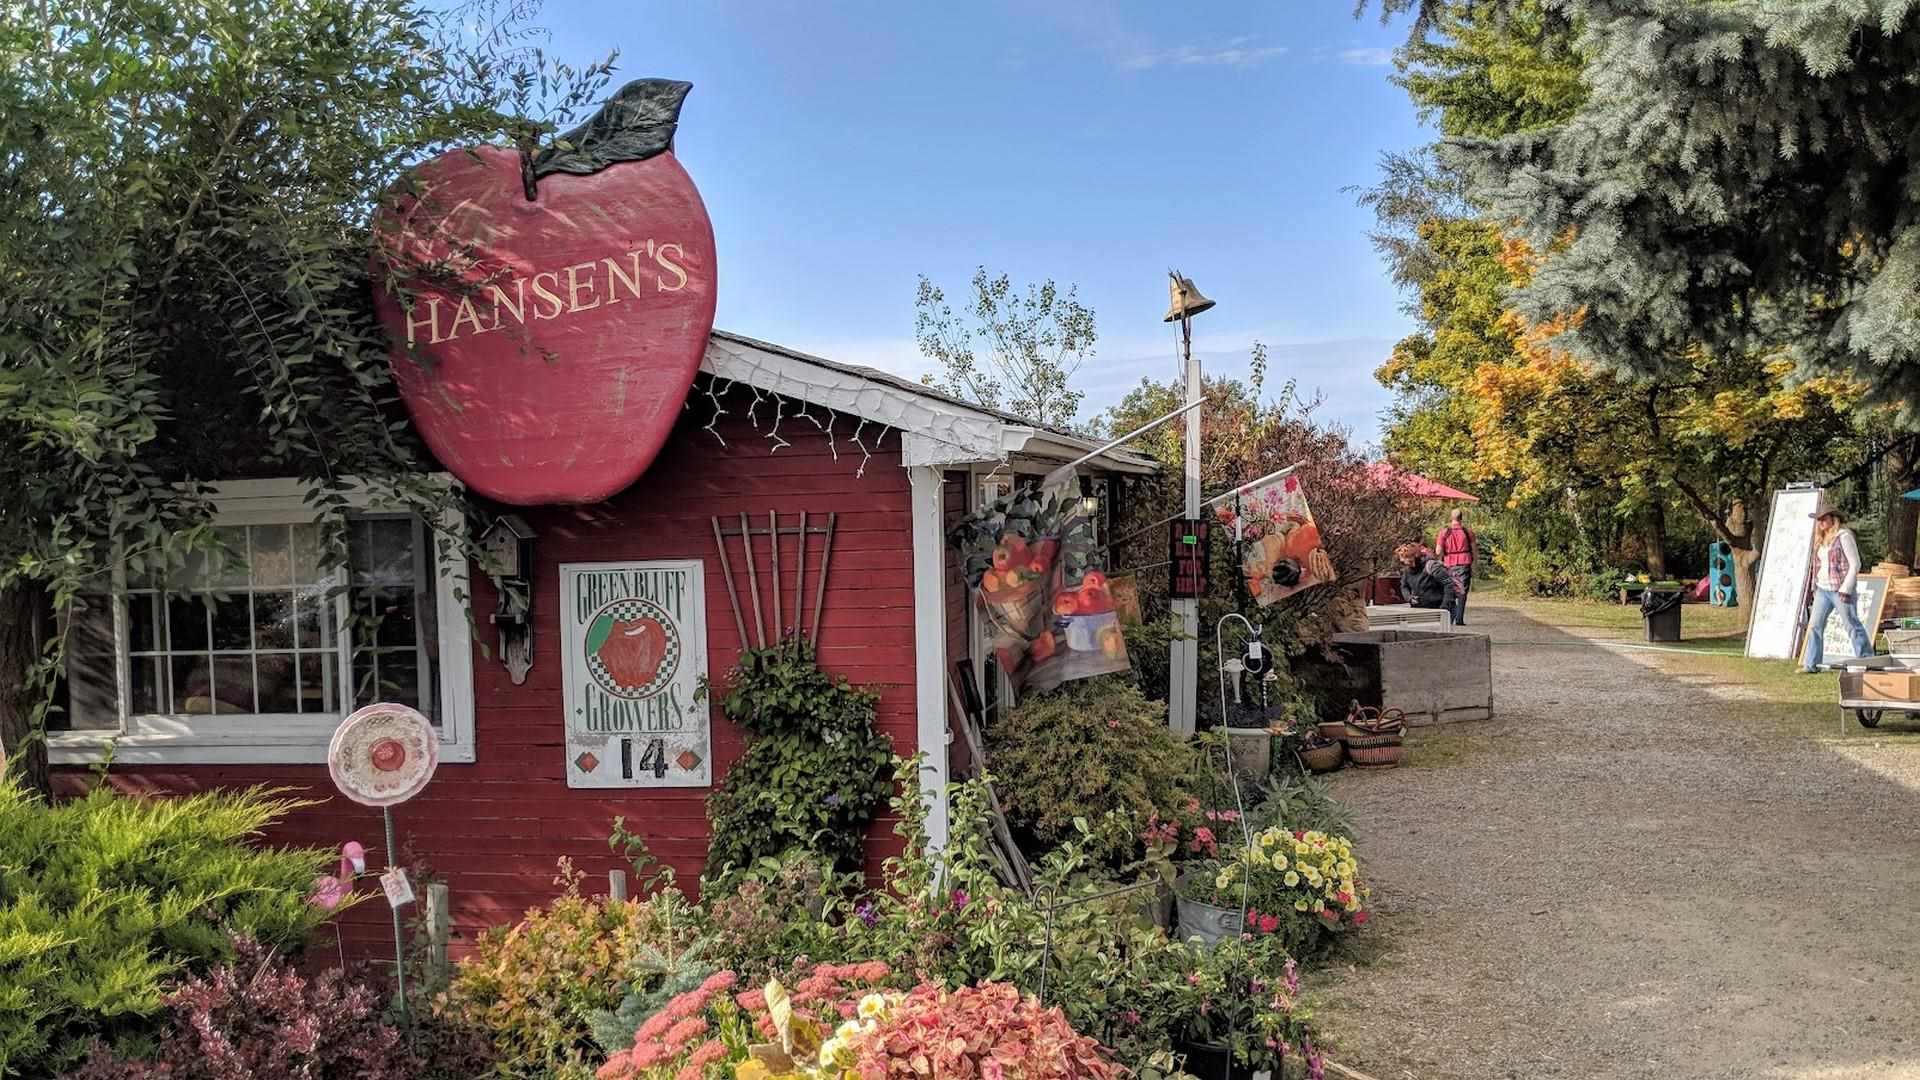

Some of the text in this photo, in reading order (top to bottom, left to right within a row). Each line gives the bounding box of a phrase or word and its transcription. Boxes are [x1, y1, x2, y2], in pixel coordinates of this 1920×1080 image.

[406, 238, 689, 349] HANSEN'S
[1175, 541, 1205, 557] BEL
[576, 570, 686, 625] GREEN BLUFF
[585, 682, 684, 732] GROWERS
[621, 738, 669, 779] 14
